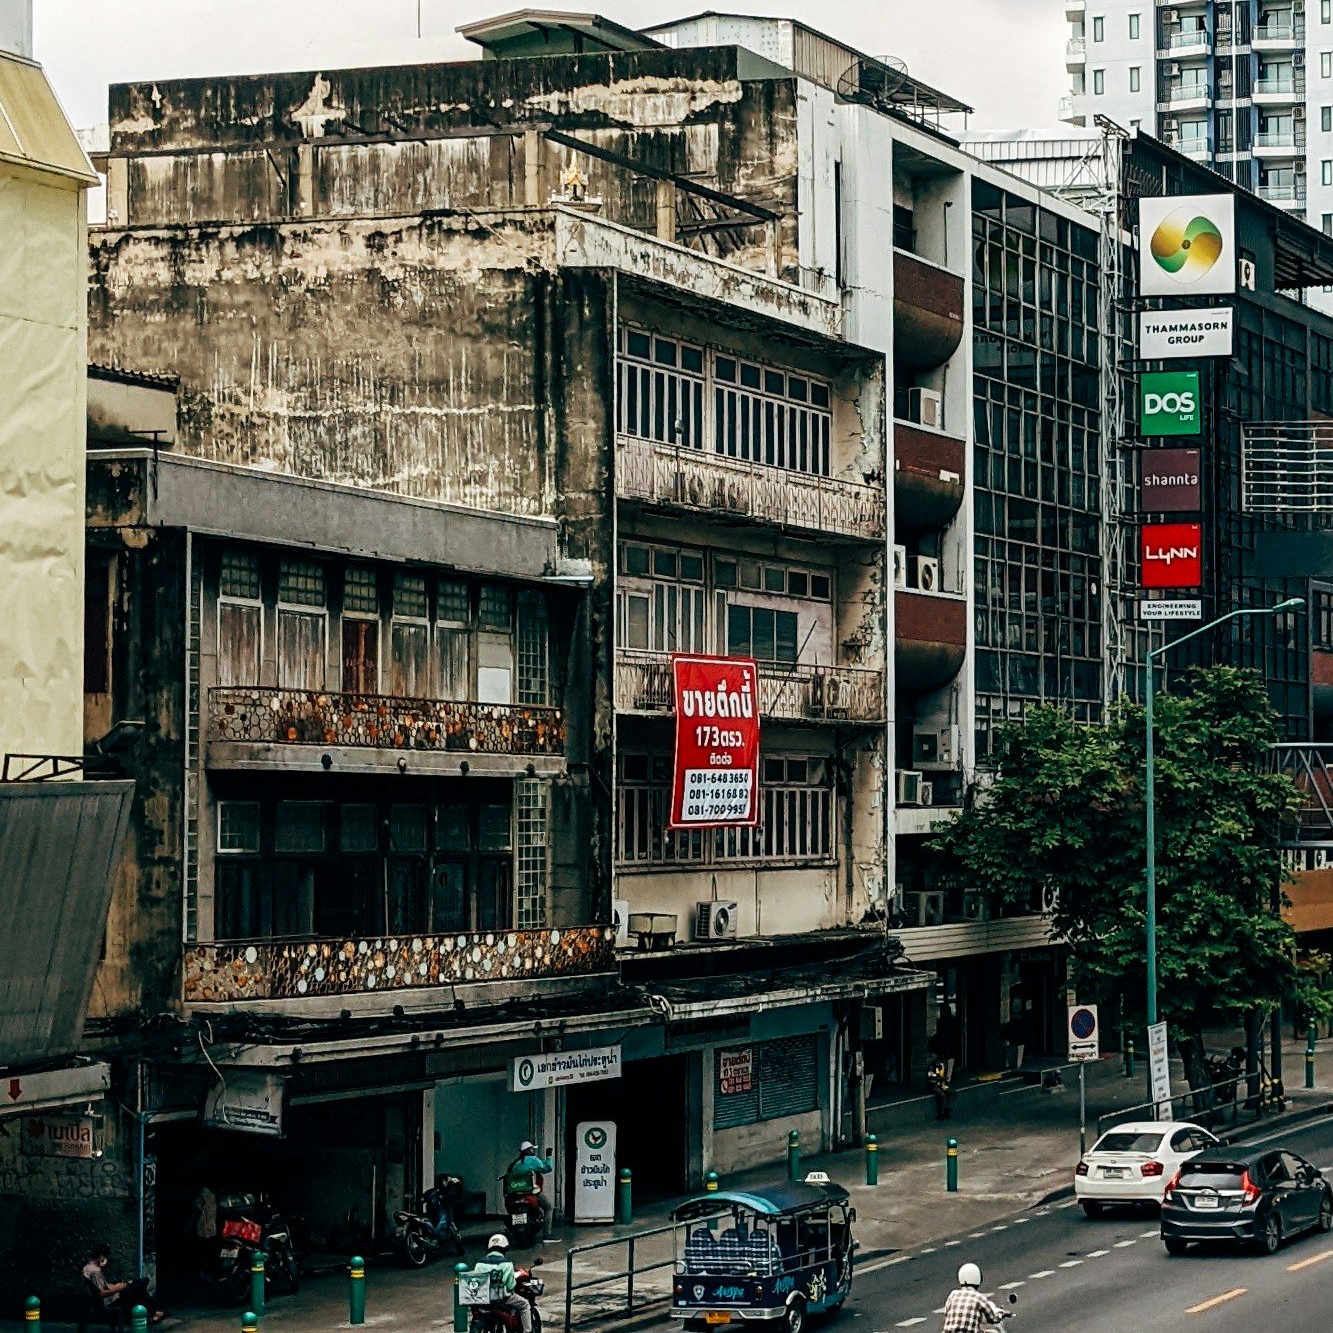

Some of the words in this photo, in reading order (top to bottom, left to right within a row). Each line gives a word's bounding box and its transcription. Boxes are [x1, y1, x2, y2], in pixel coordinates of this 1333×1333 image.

[1145, 322, 1228, 334] THAMMASORN
[1167, 335, 1205, 345] GROUP
[1144, 392, 1196, 414] DOS
[1144, 473, 1198, 486] shannta
[682, 669, 753, 719] ขายตึกนี้
